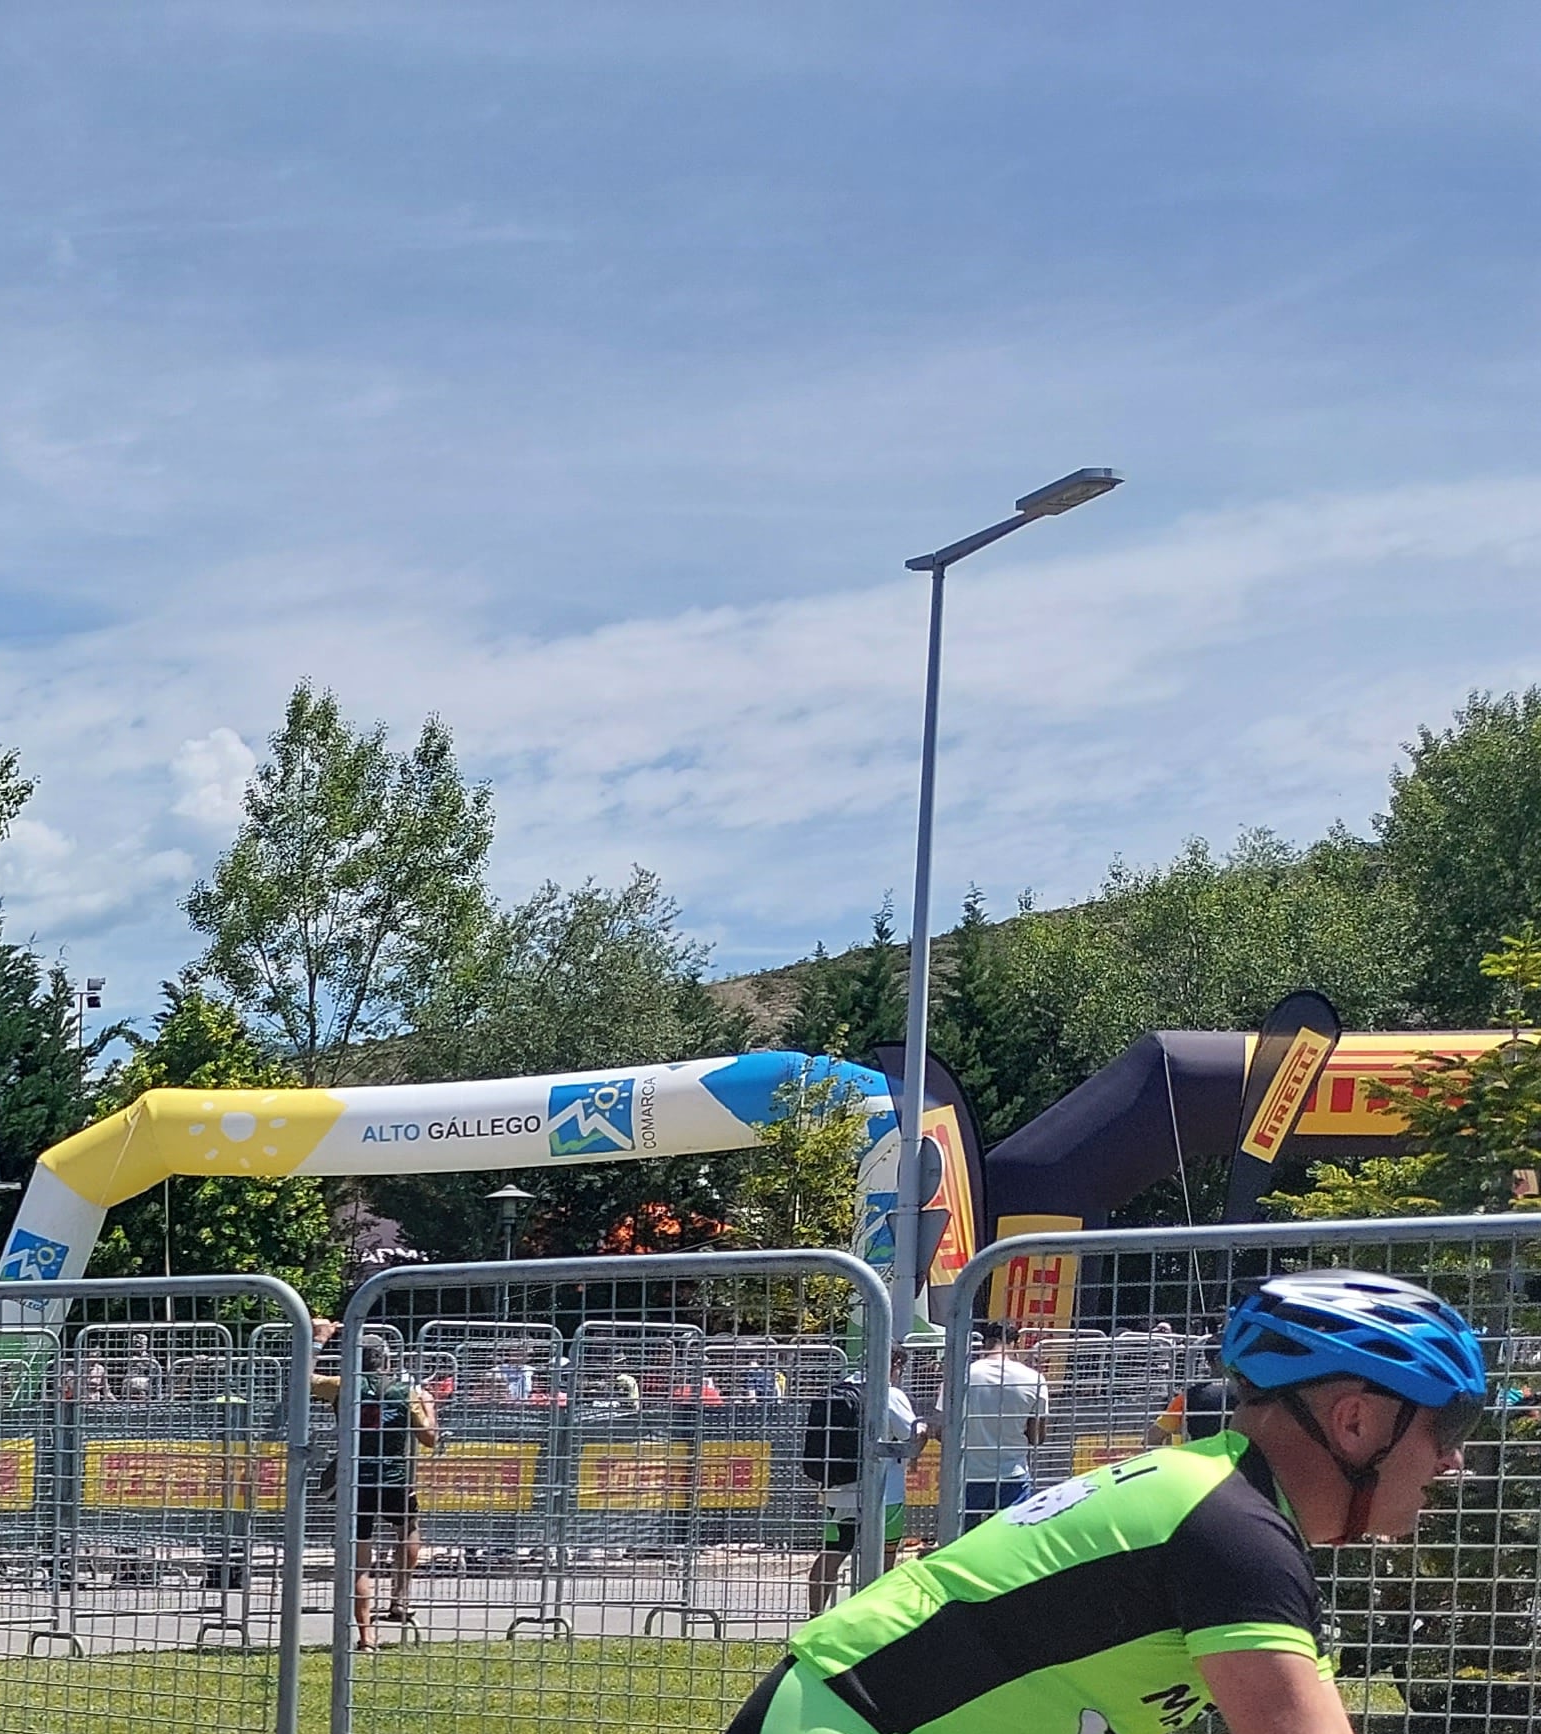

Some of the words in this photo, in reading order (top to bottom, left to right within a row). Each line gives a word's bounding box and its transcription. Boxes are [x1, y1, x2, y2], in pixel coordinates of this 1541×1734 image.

[362, 1122, 421, 1143] ALTO
[427, 1115, 542, 1141] GÁLLEGO
[641, 1076, 657, 1151] COMARCA
[1252, 1041, 1318, 1150] PIRELLI
